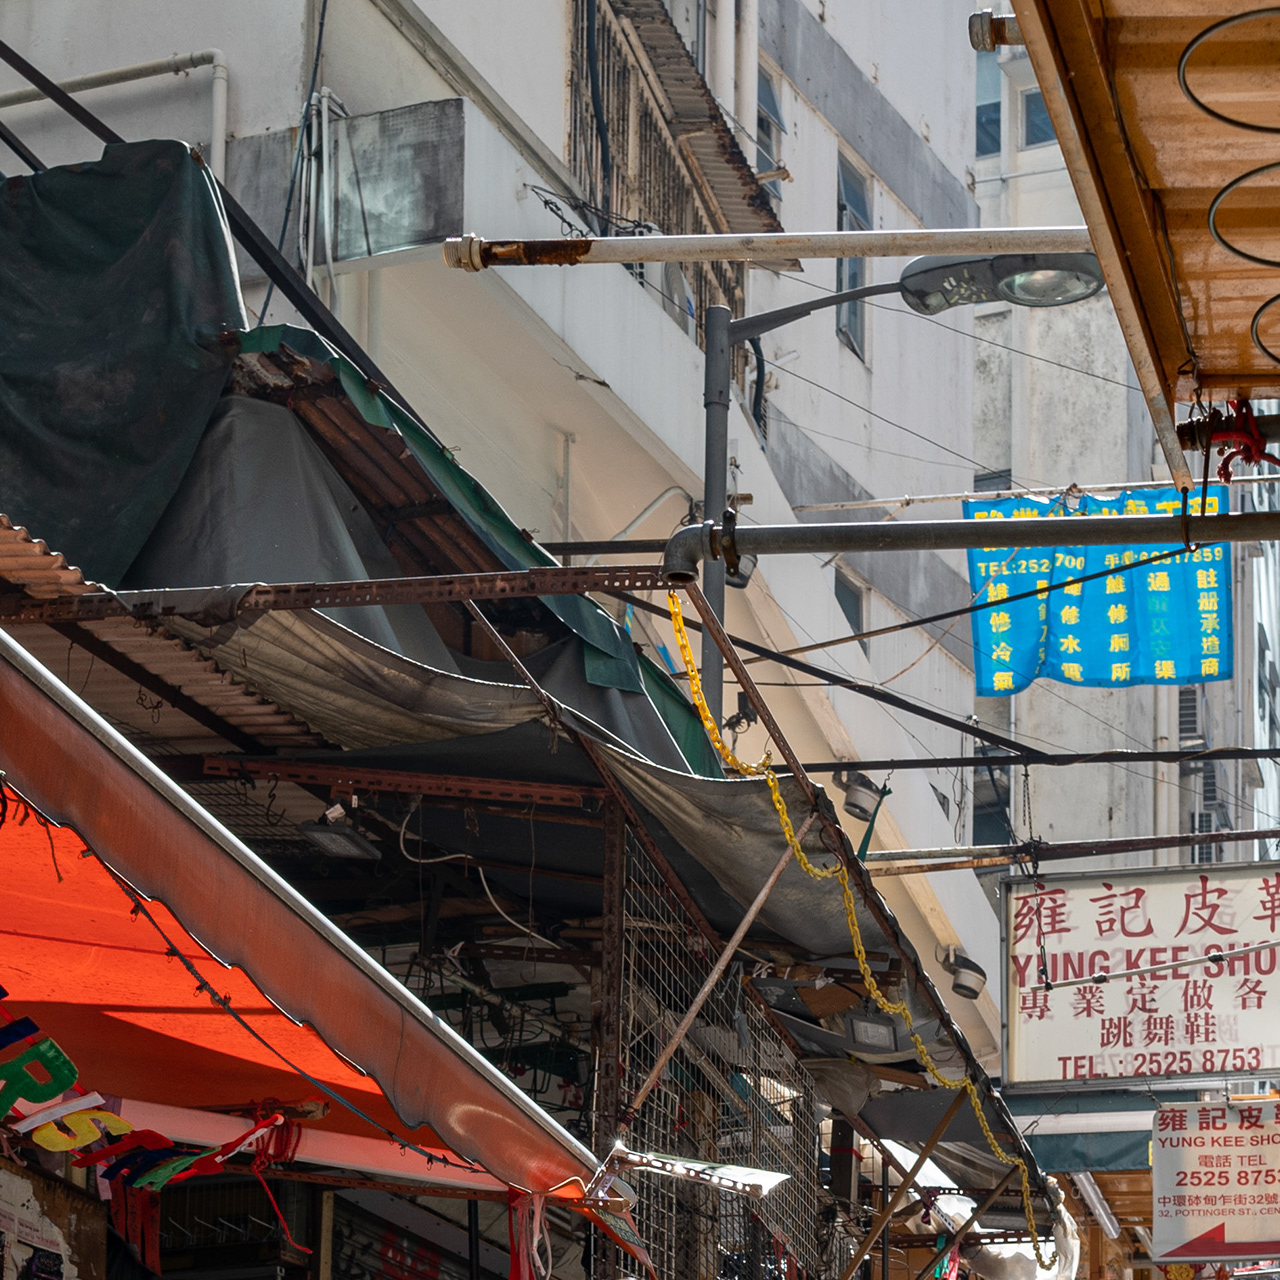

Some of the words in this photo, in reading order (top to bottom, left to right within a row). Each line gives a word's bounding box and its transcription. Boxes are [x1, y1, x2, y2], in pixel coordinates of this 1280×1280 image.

[1010, 950, 1110, 988] YUNG
[1125, 946, 1190, 983] KEE
[1100, 1013, 1218, 1049] 跳舞鞋
[1133, 1050, 1193, 1078] 2525
[1201, 1047, 1262, 1073] 8753
[1158, 1135, 1207, 1149] YUNG
[1211, 1135, 1245, 1147] KEE
[1198, 1155, 1231, 1168] 電話
[1237, 1155, 1267, 1167] TEL
[1176, 1170, 1231, 1187] 2525
[1175, 1207, 1236, 1217] POTTINGER
